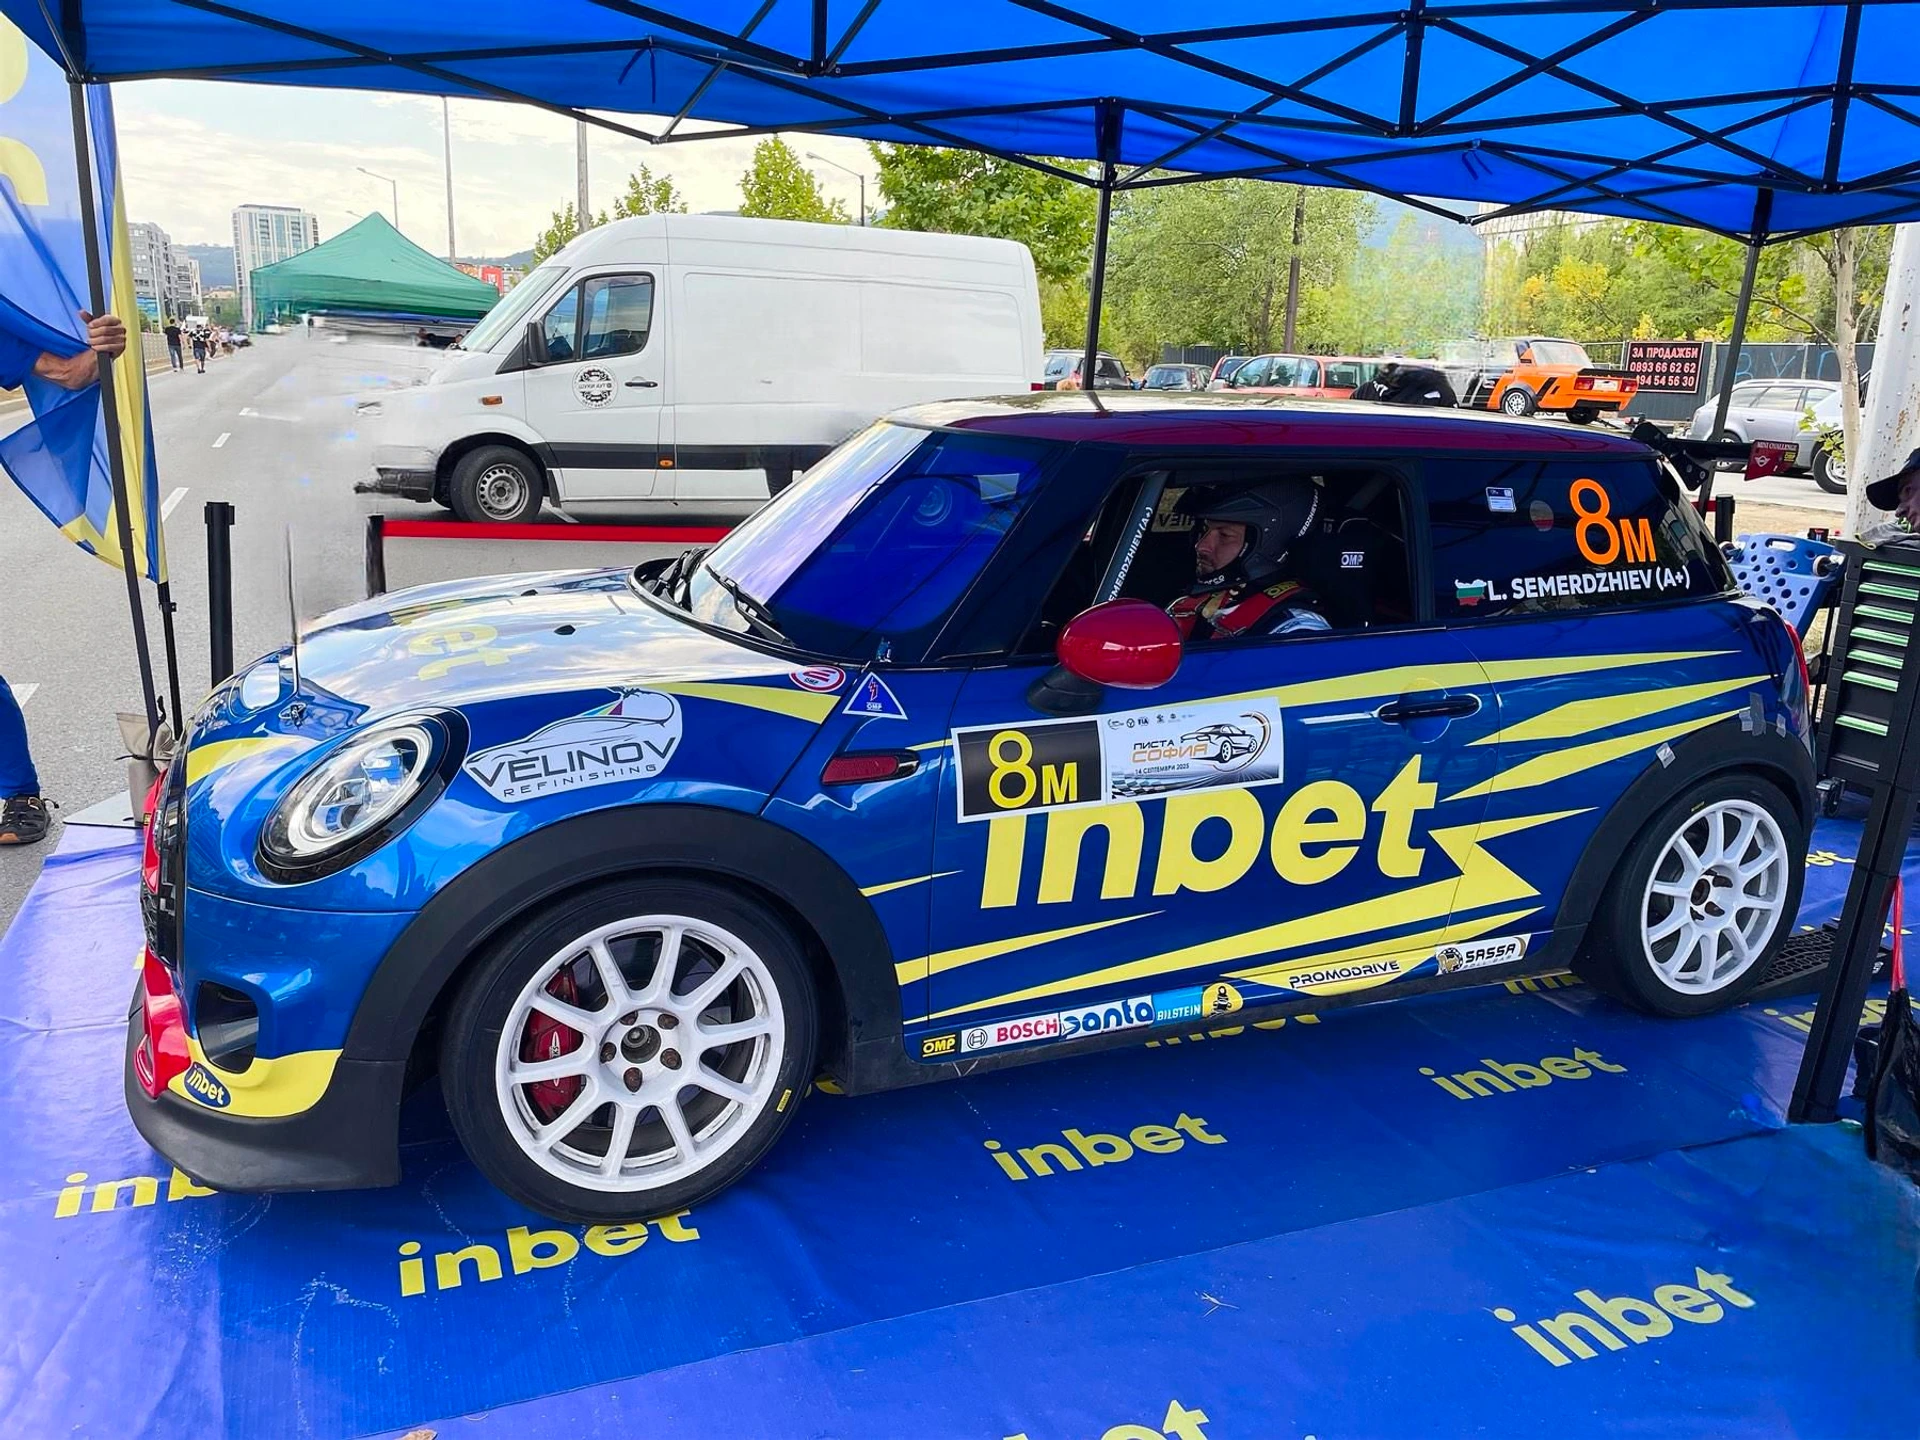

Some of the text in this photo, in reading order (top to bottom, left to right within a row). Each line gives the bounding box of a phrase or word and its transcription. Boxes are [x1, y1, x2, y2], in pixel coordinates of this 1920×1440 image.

[1630, 361, 1696, 374] 0893 66 62 62
[1632, 347, 1699, 359] ЗА ПРОДАЖБИ
[1636, 374, 1695, 387] 94 54 56 30
[1569, 478, 1657, 566] 8M
[1109, 530, 1143, 601] EMERDZHIEV
[1341, 553, 1364, 567] OMP
[1487, 564, 1691, 601] L. SEMERDZHIEV (A+)
[1131, 743, 1208, 764] СОФИЯ
[1133, 738, 1175, 751] ПИСТА
[470, 737, 676, 788] VELINOV
[988, 730, 1078, 809] 8M
[503, 764, 657, 798] REFINISHING
[1466, 943, 1516, 964] SASSA
[1289, 960, 1400, 989] PROMODRIVE
[1157, 1004, 1201, 1022] BILSTEIN
[923, 1036, 956, 1055] OMP
[996, 1018, 1059, 1043] BOSCH
[187, 1064, 225, 1106] inbet
[1418, 1046, 1627, 1100] inbet
[984, 1113, 1228, 1181] inbet
[398, 1209, 700, 1298] inbet
[1493, 1266, 1756, 1368] inbet
